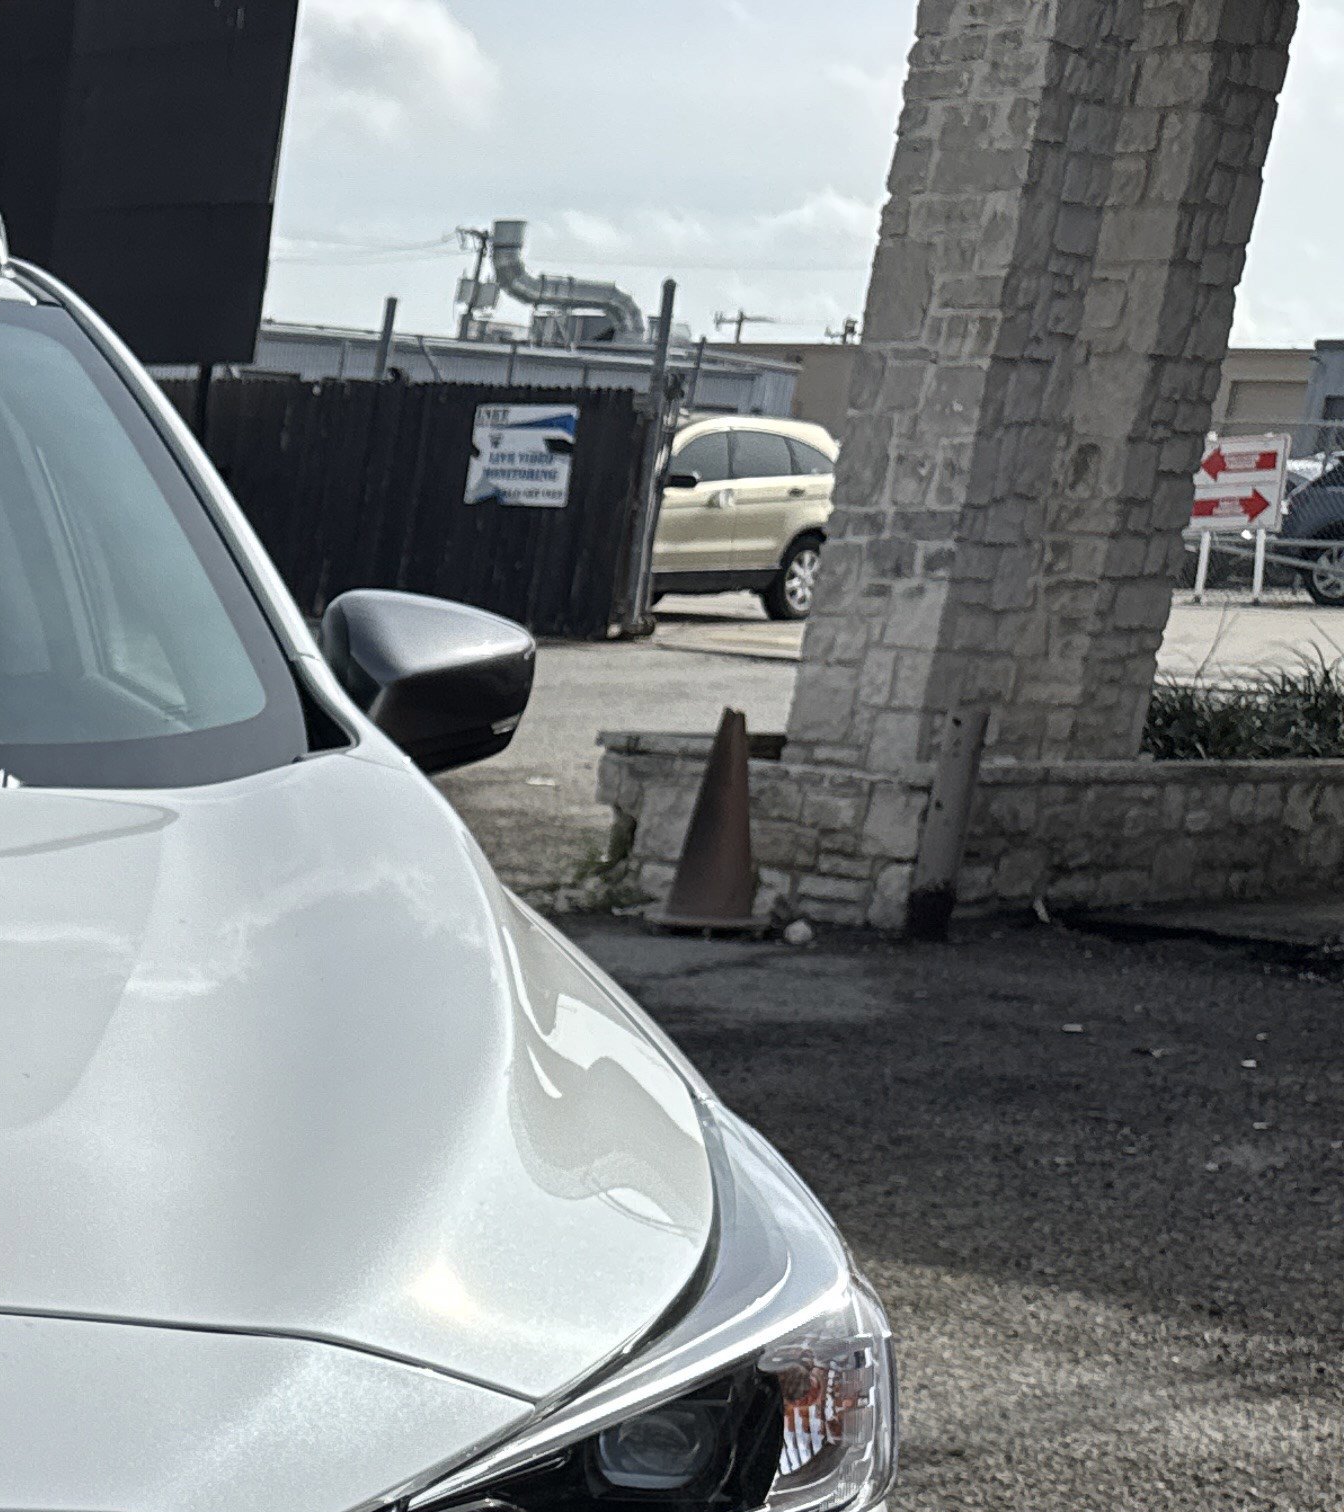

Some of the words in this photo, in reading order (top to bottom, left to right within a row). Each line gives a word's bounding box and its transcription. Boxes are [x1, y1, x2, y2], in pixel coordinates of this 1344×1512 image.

[489, 452, 516, 463] LIVE
[518, 452, 555, 464] VIDEO
[483, 467, 559, 480] MONITORING
